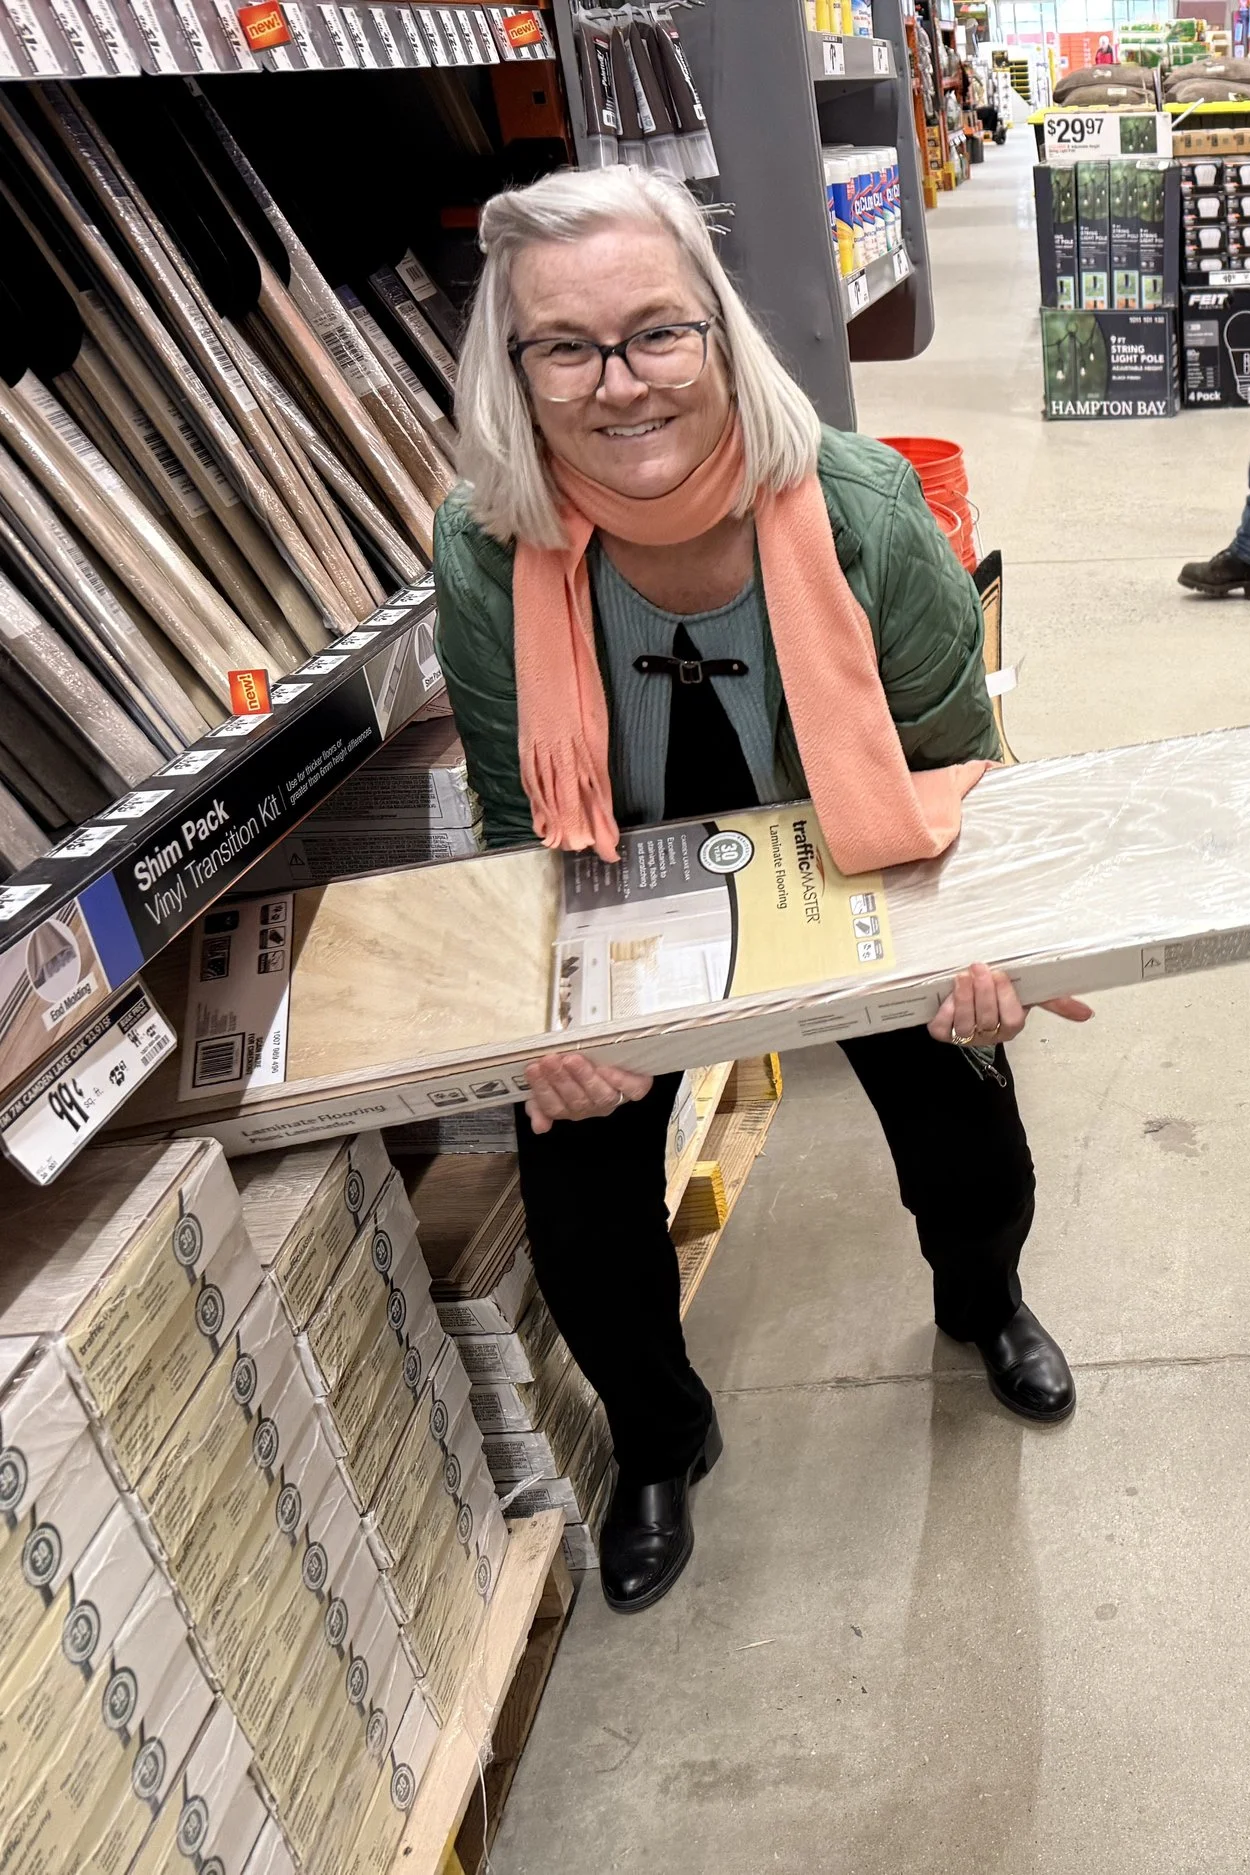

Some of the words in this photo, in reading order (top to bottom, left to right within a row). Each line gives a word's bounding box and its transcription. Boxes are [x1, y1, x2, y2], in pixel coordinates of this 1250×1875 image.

[249, 13, 282, 37] new!
[509, 19, 537, 40] new!
[1188, 293, 1229, 306] FEIT
[1110, 335, 1116, 344] 9
[1111, 345, 1145, 354] STRING
[1111, 354, 1139, 363] LIGHT
[1140, 354, 1165, 363] POLE
[1051, 400, 1133, 416] HAMPTON
[1137, 400, 1167, 416] BAY
[1188, 391, 1196, 400] 4
[1196, 391, 1221, 401] Pack
[239, 675, 259, 710] new!
[285, 777, 299, 792] Use
[297, 768, 306, 784] for
[304, 755, 323, 777] thicker
[321, 744, 338, 761] floors
[290, 781, 309, 805] greater
[308, 771, 321, 788] than
[319, 761, 334, 777] 6mm
[332, 748, 349, 768] height
[346, 726, 373, 753] differences
[133, 840, 183, 892] Shim
[181, 799, 230, 851] Pack
[144, 874, 188, 926] Vinyl
[184, 816, 260, 888] Transition
[259, 793, 282, 828] Kit
[667, 836, 677, 866] Excellent
[711, 845, 723, 863] YEAR
[721, 842, 739, 862] 30
[769, 824, 783, 869] Laminate
[775, 867, 788, 909] Flooring
[792, 820, 821, 925] trafficMASTER
[50, 1007, 63, 1023] End
[62, 983, 92, 1014] Molding
[22, 1075, 55, 1105] CAMDEN
[52, 1054, 72, 1077] LAKE
[70, 1039, 89, 1058] OAK
[242, 1117, 317, 1138] Laminate
[317, 1103, 386, 1126] Flooring
